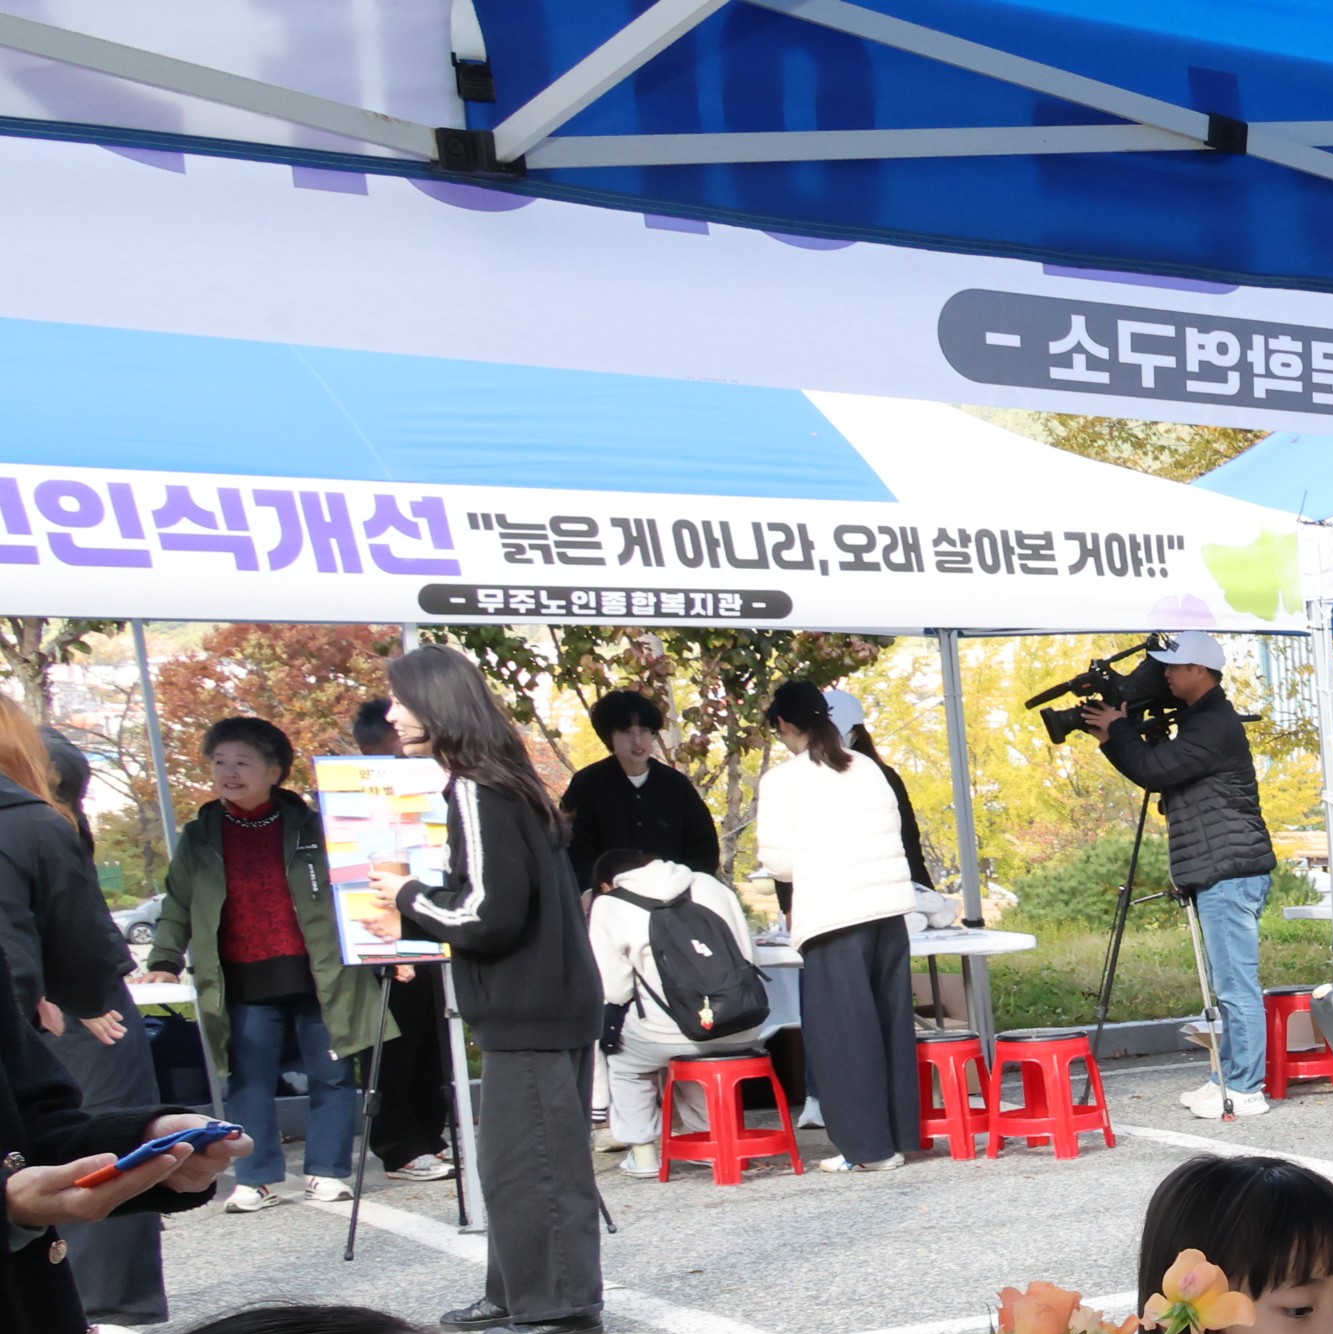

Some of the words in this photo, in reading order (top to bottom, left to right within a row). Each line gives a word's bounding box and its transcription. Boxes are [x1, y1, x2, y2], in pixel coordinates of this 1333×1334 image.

[469, 515, 605, 566] "늙은
[612, 520, 664, 567] 게
[673, 521, 829, 576] 아니라,
[835, 527, 921, 572] 오래
[934, 530, 1058, 575] 살아본
[479, 589, 743, 617] 무주노인종합복지관
